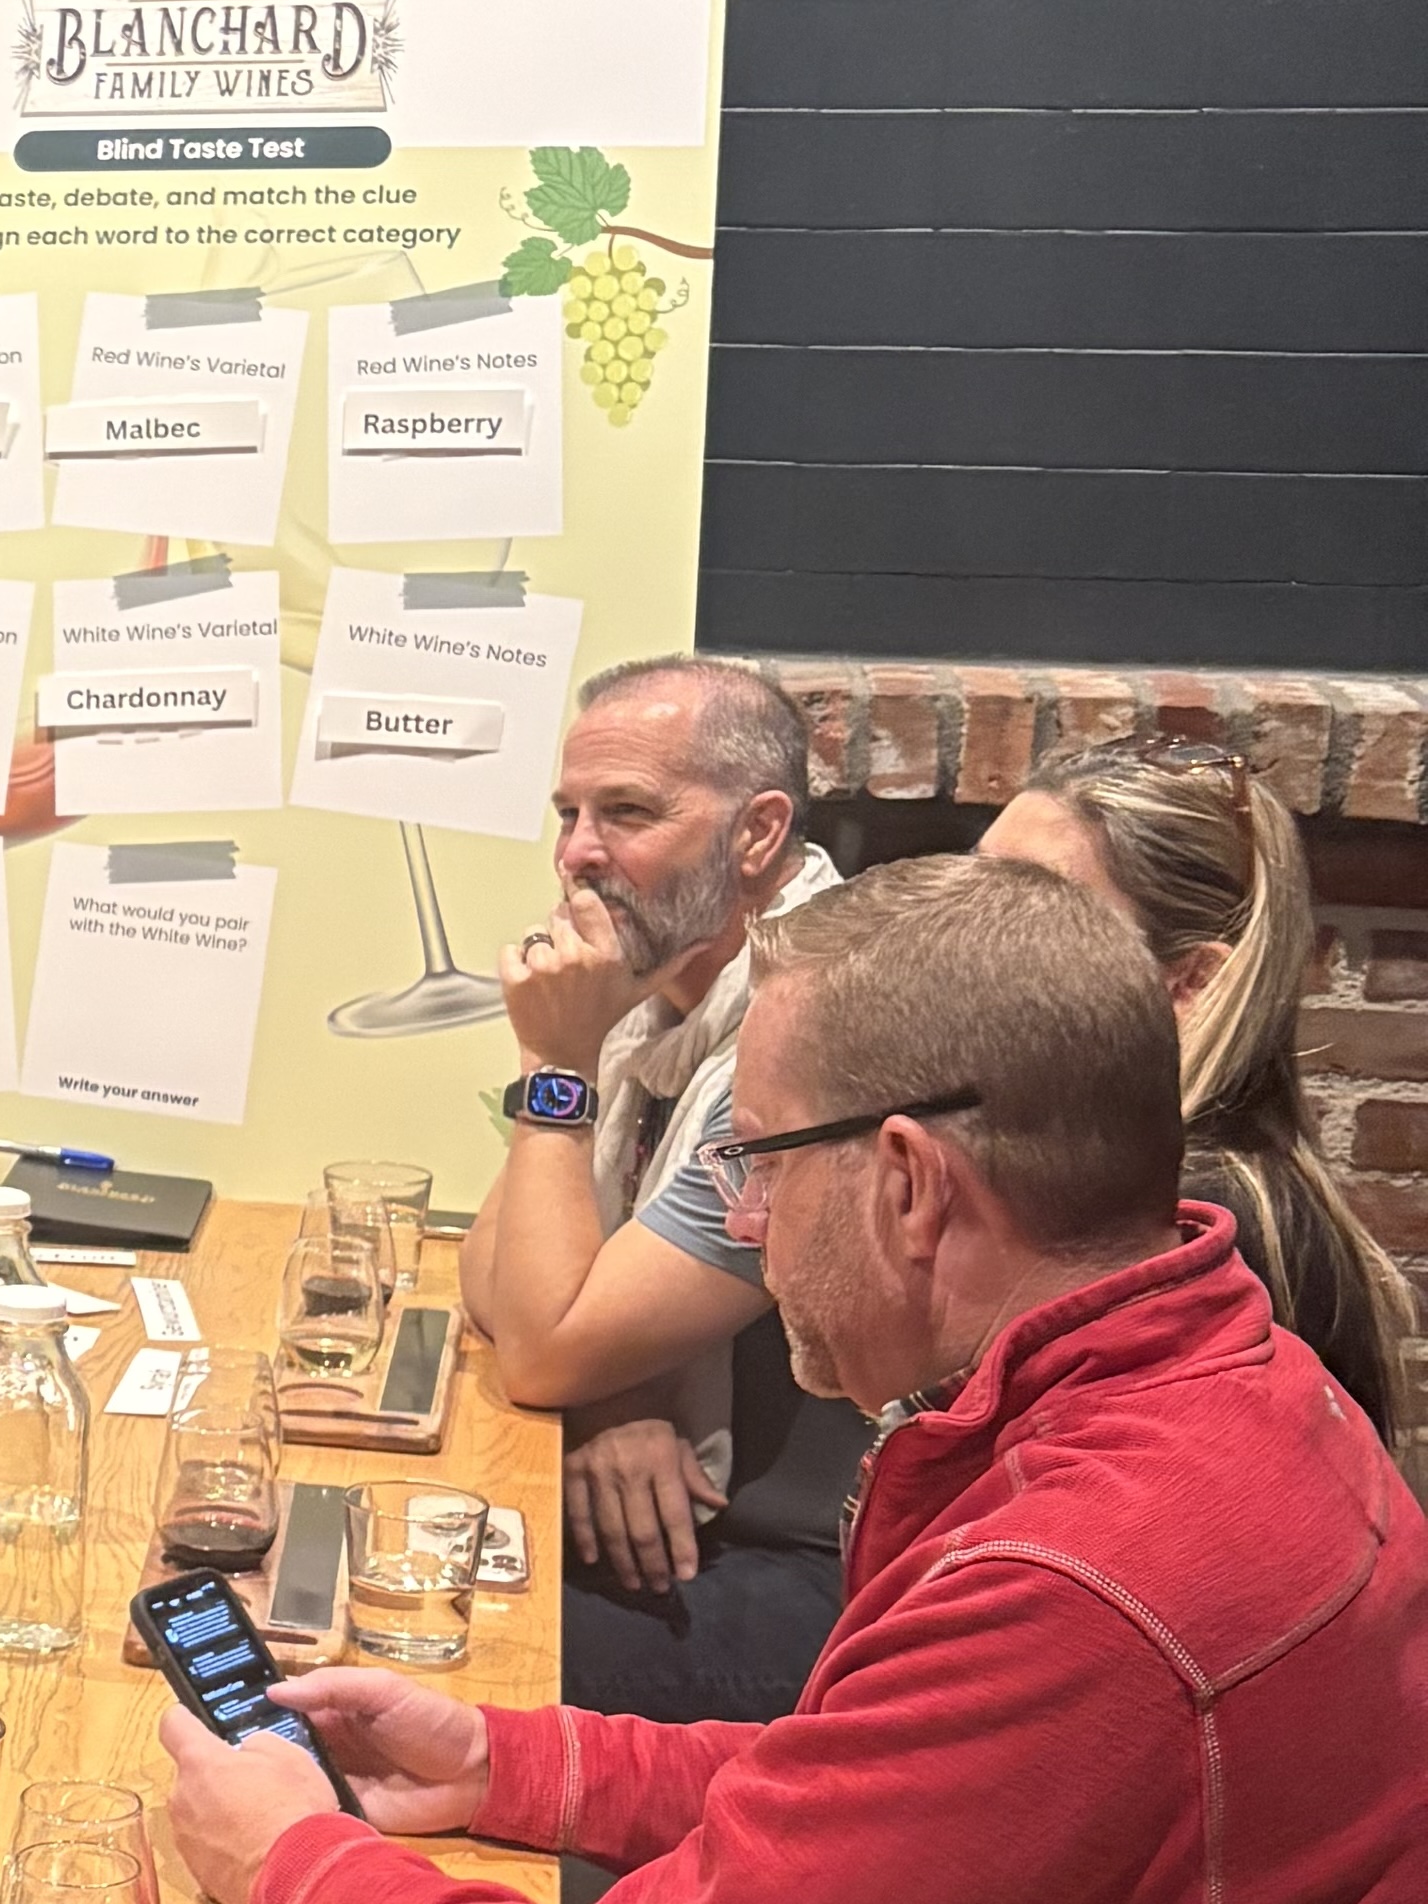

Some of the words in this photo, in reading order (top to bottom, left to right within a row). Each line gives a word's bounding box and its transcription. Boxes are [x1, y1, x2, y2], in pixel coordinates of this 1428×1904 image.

[46, 2, 367, 85] BLANCHARD
[94, 71, 200, 99] FAMILY
[214, 69, 314, 97] WINES
[97, 139, 162, 161] Blind
[170, 138, 242, 159] Taste
[249, 137, 305, 158] Test
[64, 188, 159, 208] debate,
[167, 187, 216, 205] and
[223, 186, 306, 205] match
[315, 185, 355, 204] the
[363, 185, 417, 204] clue
[27, 226, 88, 245] each
[95, 226, 158, 244] word
[165, 227, 189, 244] to
[197, 225, 237, 244] the
[244, 226, 336, 243] correct
[343, 225, 461, 249] category
[92, 347, 131, 364] Red
[136, 352, 200, 371] Wine's
[207, 357, 285, 378] Varietal
[358, 358, 396, 375] Red
[403, 355, 471, 373] Wine's
[477, 353, 537, 369] Notes
[107, 418, 200, 440] Malbec
[364, 412, 502, 439] Raspberry
[63, 626, 120, 643] White
[126, 624, 192, 641] Wine's
[198, 619, 277, 638] Varietal
[349, 625, 407, 647] White
[414, 634, 481, 658] Wine's
[486, 644, 546, 667] Notes
[67, 687, 226, 711] Chardonnay
[366, 711, 453, 735] Butter
[73, 897, 118, 915] What
[122, 906, 175, 922] would
[179, 912, 210, 927] you
[215, 917, 249, 932] pair
[70, 918, 104, 933] with
[109, 922, 137, 938] the
[142, 926, 190, 945] White
[196, 933, 247, 952] Wine?
[59, 1076, 99, 1092] Write
[103, 1084, 138, 1098] your
[141, 1091, 199, 1107] answer
